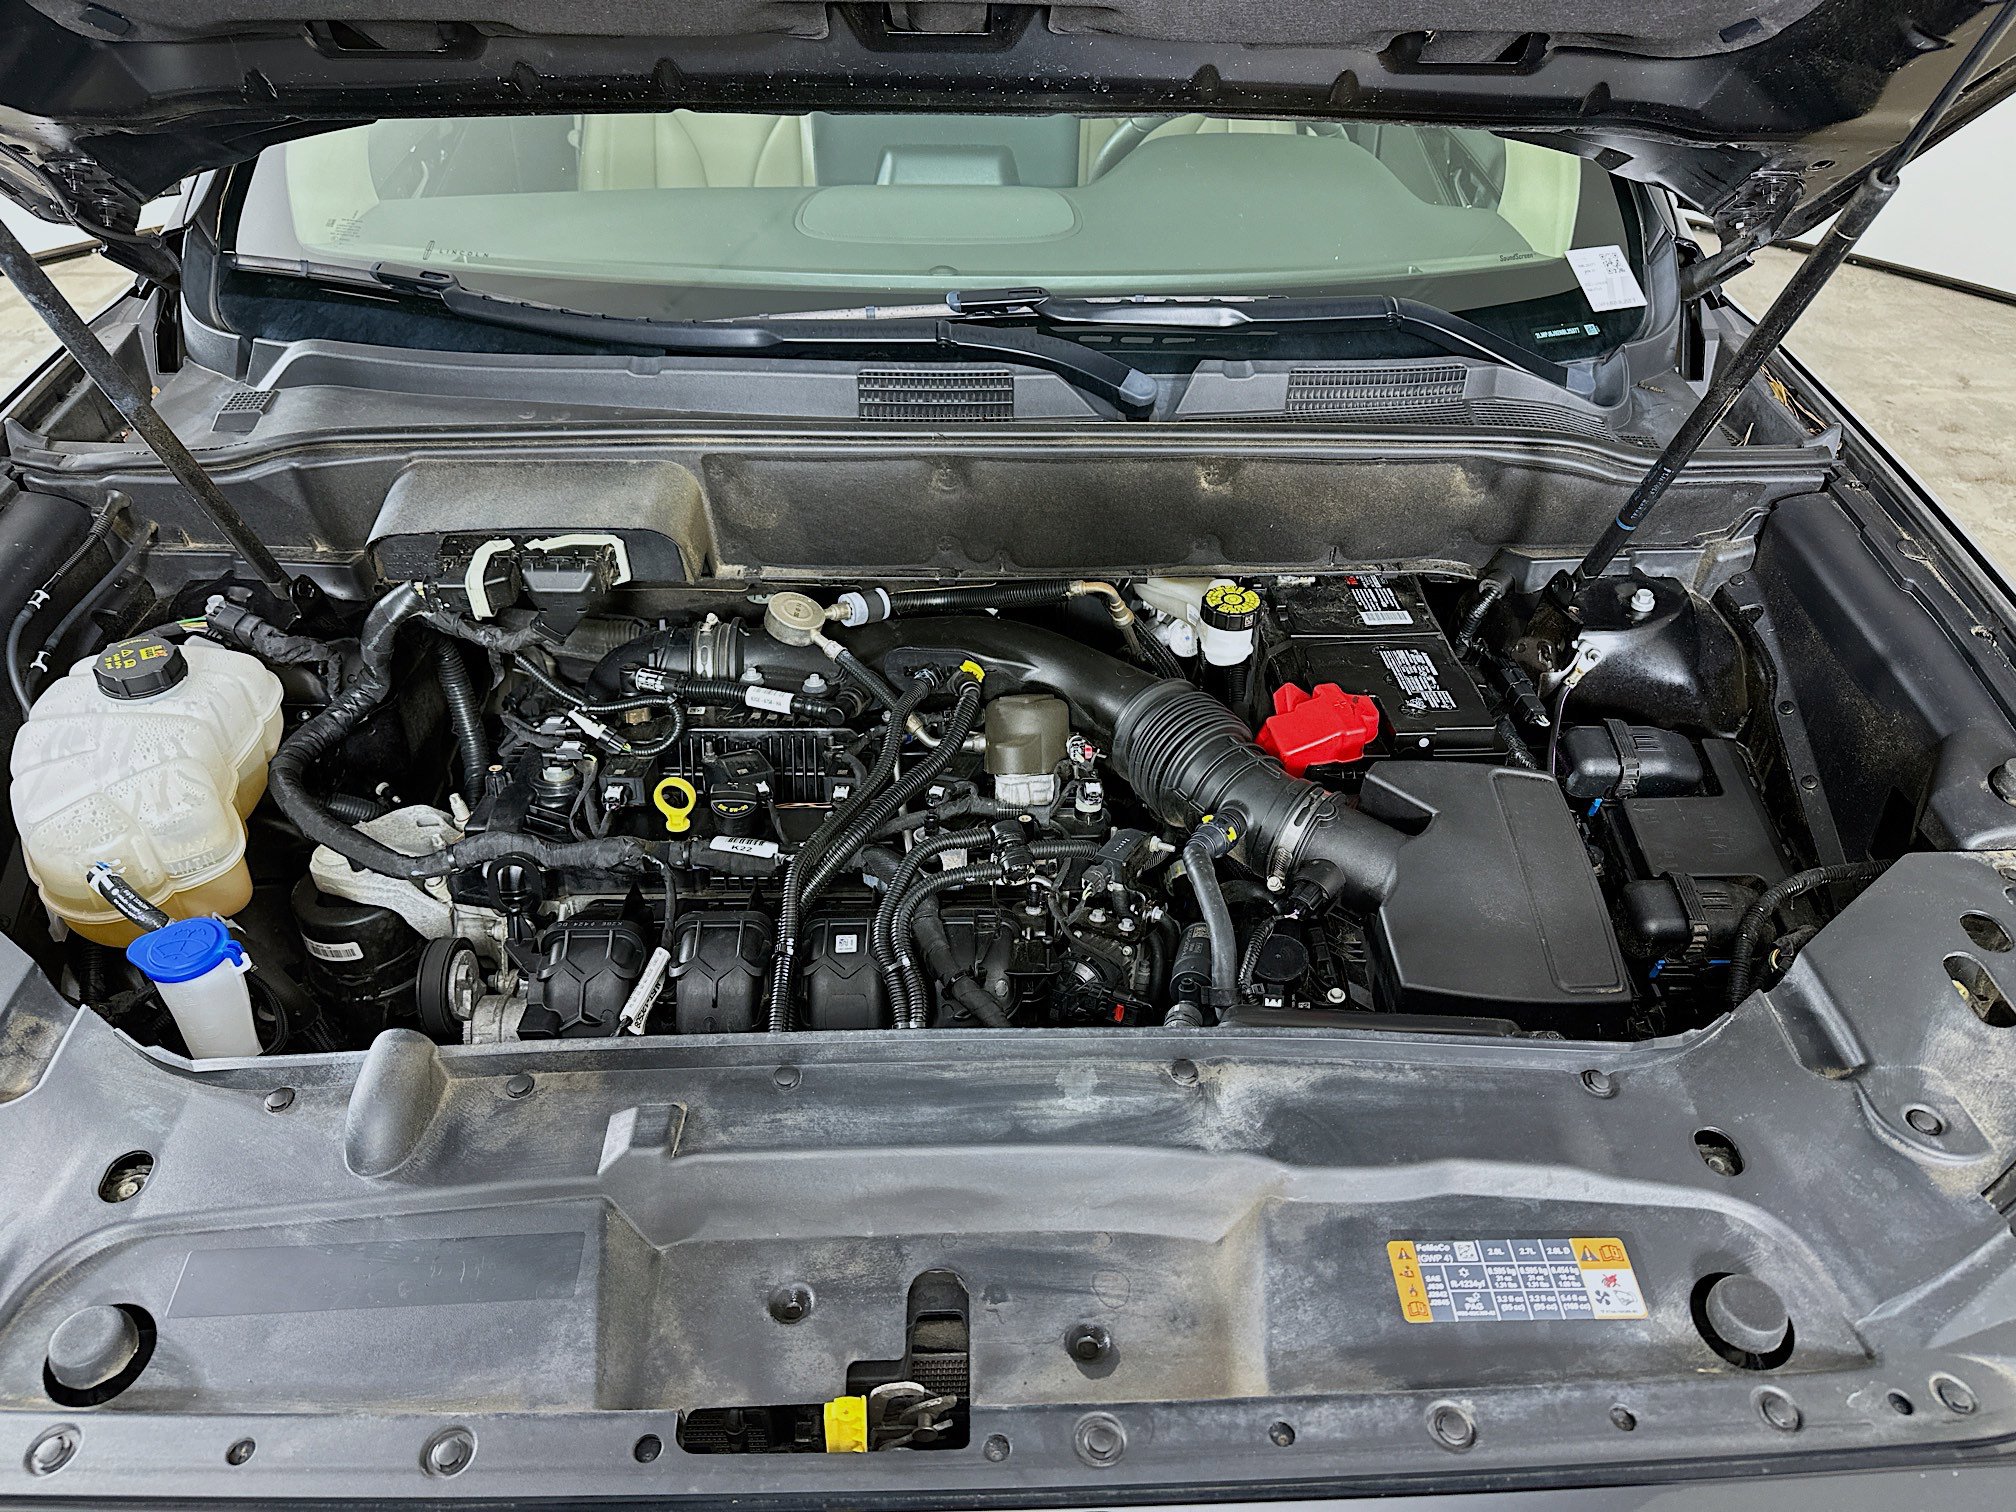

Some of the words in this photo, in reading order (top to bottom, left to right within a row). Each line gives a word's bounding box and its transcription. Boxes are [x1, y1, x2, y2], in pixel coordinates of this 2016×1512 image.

[440, 249, 489, 258] LINCOLN
[731, 844, 752, 852] K22
[1415, 1243, 1450, 1252] FoMoCo
